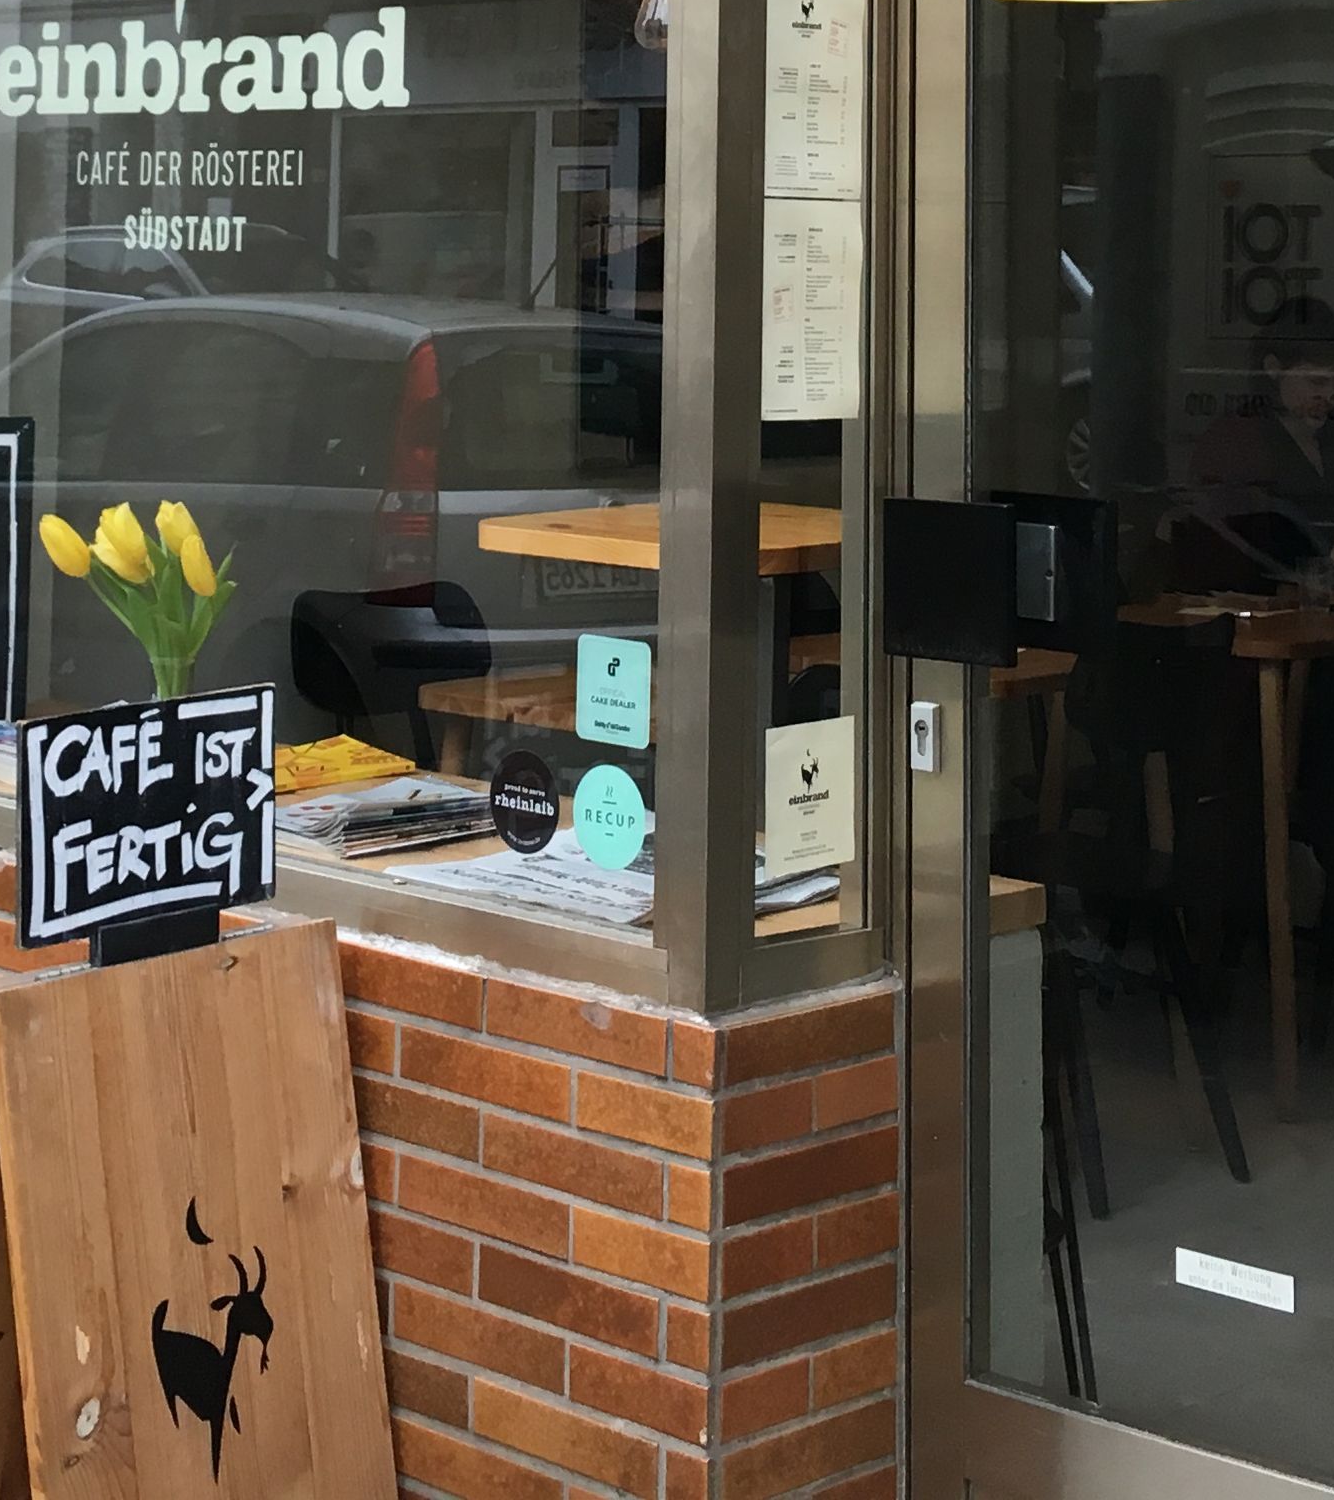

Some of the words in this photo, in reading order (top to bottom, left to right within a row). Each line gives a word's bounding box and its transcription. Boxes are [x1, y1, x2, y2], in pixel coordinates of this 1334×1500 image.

[76, 142, 131, 187] CAFÉ
[139, 150, 182, 187] DER
[191, 143, 304, 187] RÖSTEREI
[123, 207, 247, 252] SÜDSTADT
[590, 695, 608, 706] CAKE
[610, 697, 636, 710] DEALER
[44, 708, 173, 796] CAFÉ
[195, 726, 256, 784] IST
[495, 793, 555, 817] rheinlaib
[788, 789, 830, 806] einbrand
[584, 808, 636, 829] RECUP
